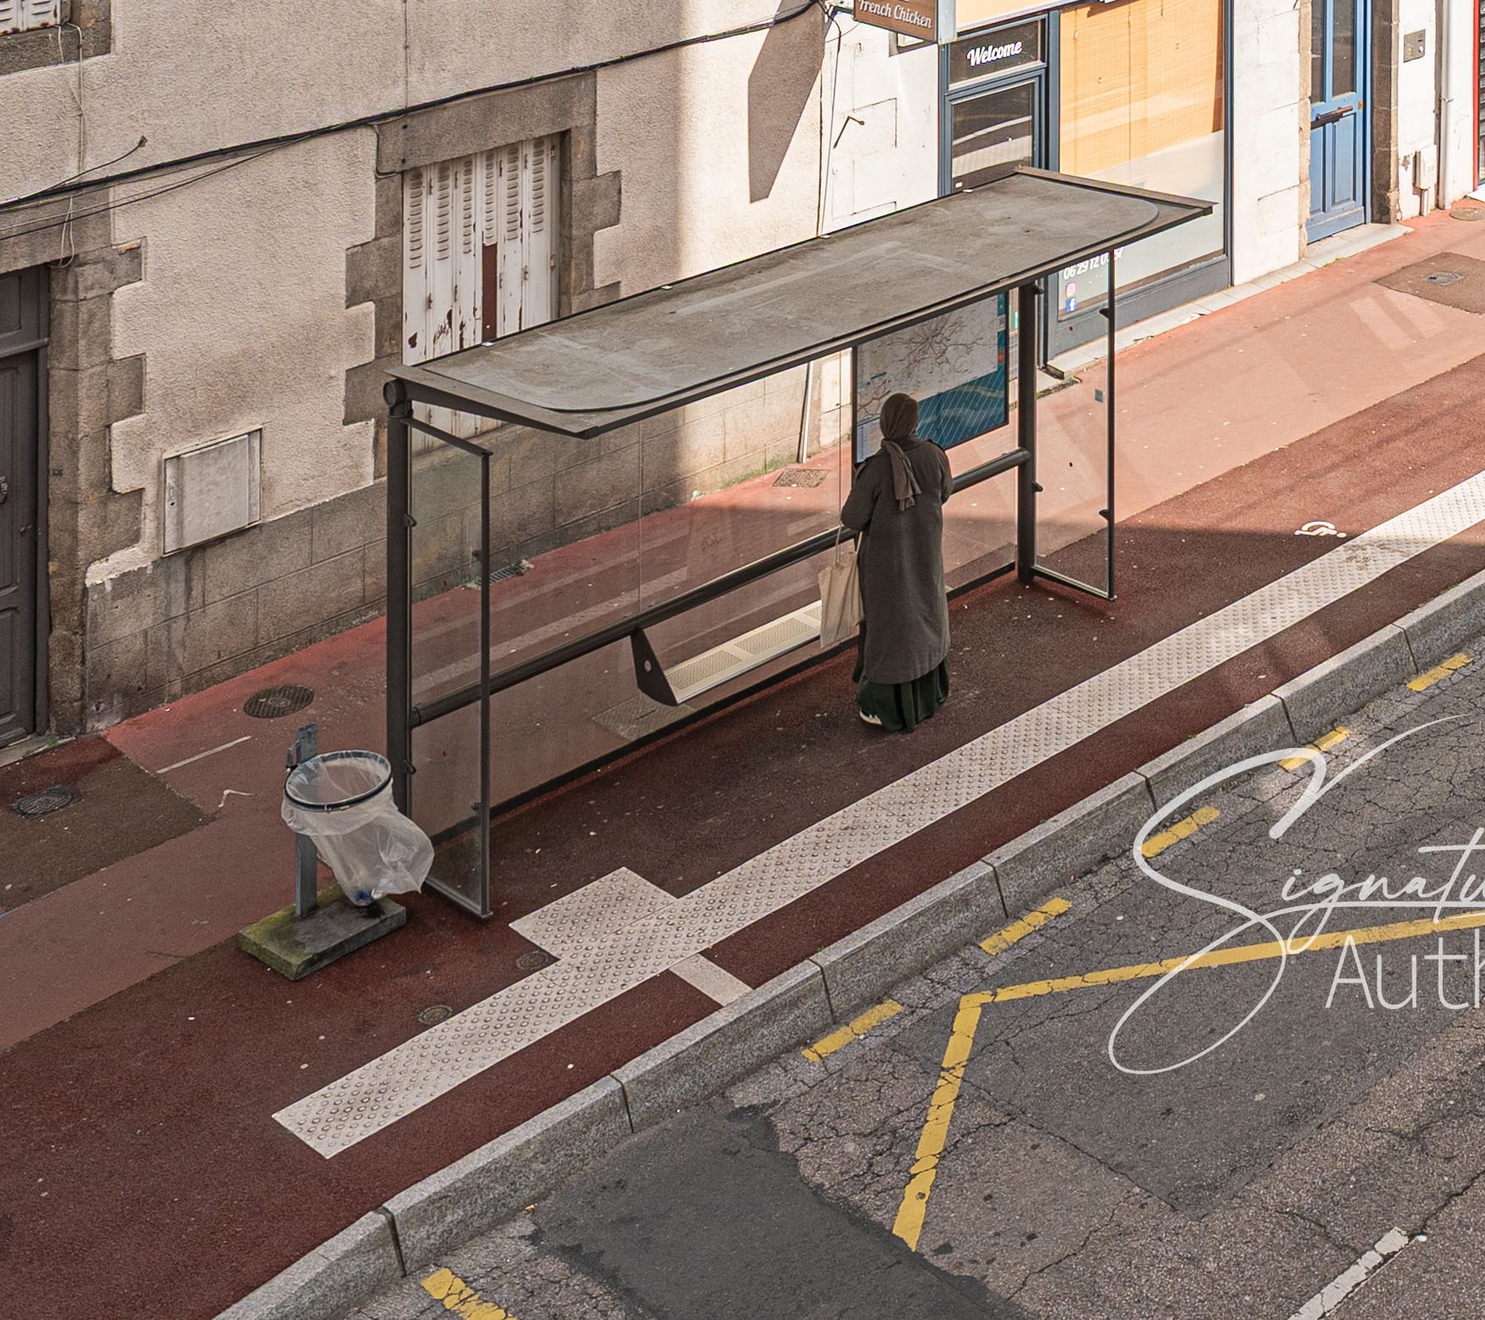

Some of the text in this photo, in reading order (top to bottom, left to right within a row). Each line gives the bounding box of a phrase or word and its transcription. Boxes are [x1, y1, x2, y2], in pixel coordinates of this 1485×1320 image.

[892, 4, 933, 29] Chicken
[966, 39, 1023, 67] Welcome
[1100, 251, 1110, 266] 0
